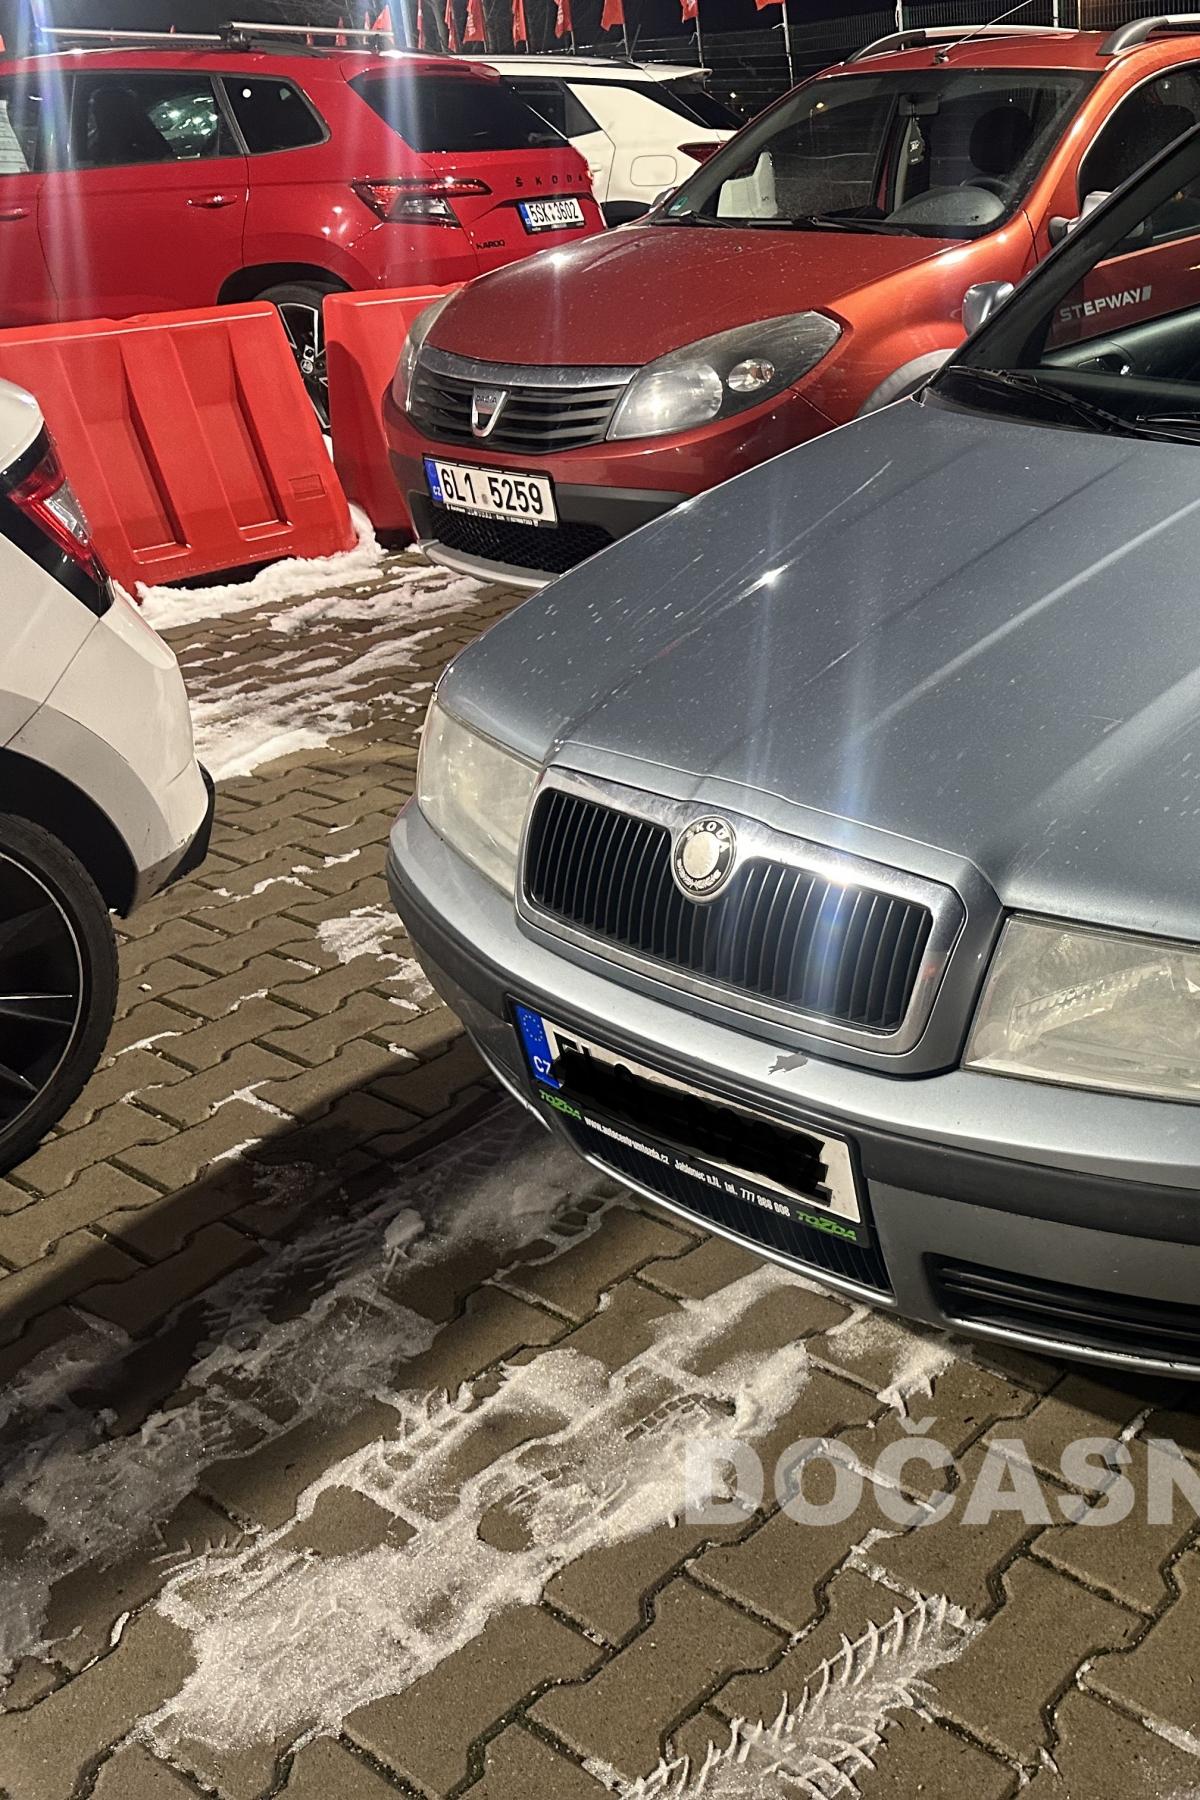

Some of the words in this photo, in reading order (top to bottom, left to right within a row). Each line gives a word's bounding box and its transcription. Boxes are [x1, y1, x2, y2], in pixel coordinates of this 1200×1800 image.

[529, 203, 551, 223] 5SK
[553, 201, 579, 220] 3602
[1059, 288, 1141, 322] STEPWAY
[441, 468, 477, 504] 6L1
[487, 476, 543, 515] 5259
